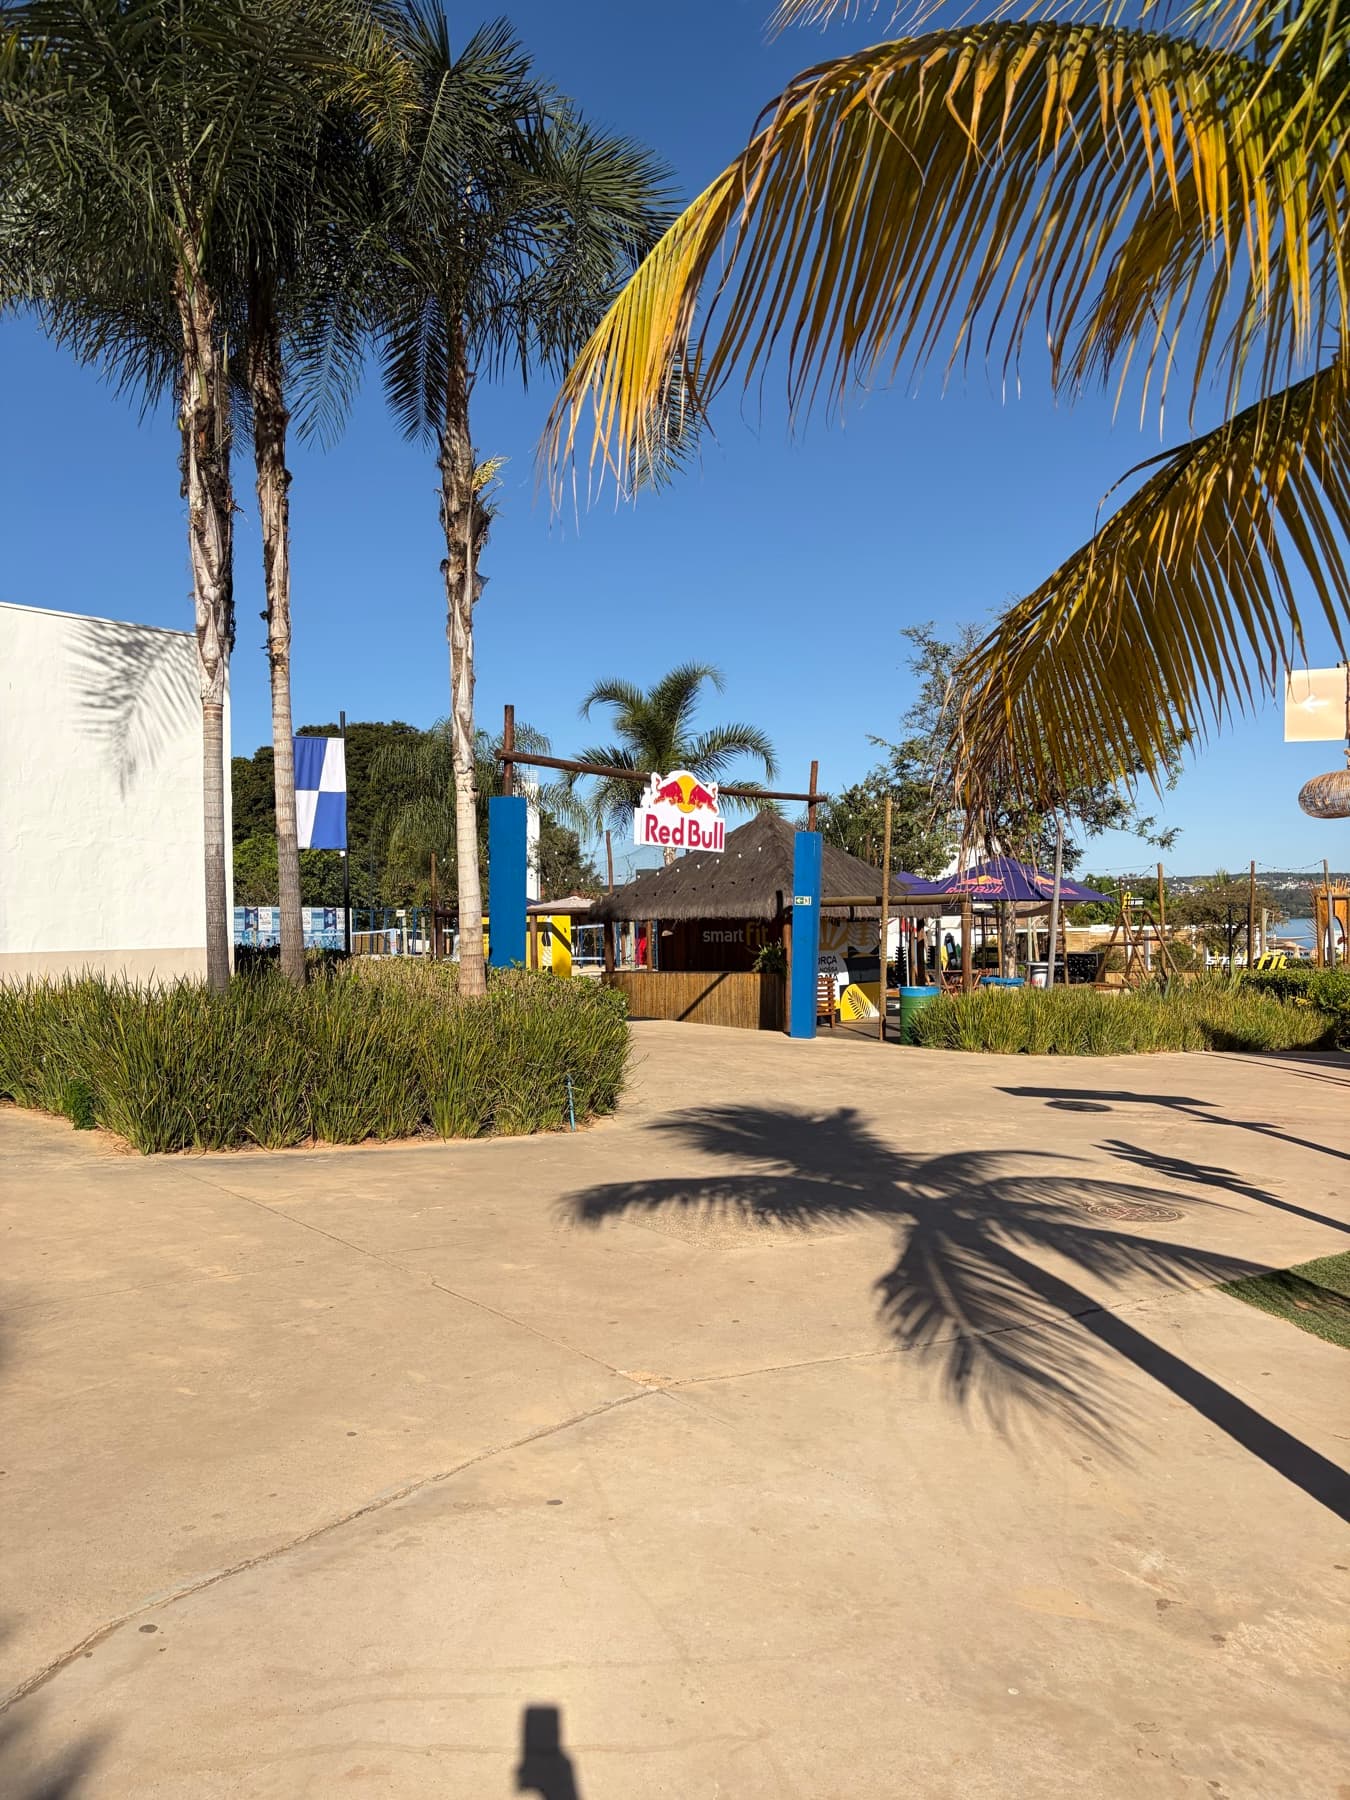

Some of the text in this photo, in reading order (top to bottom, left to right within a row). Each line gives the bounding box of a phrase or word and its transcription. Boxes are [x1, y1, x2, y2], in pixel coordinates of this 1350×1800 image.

[645, 813, 724, 850] Red Bull
[702, 921, 769, 946] smart fit
[818, 956, 838, 966] RÇA
